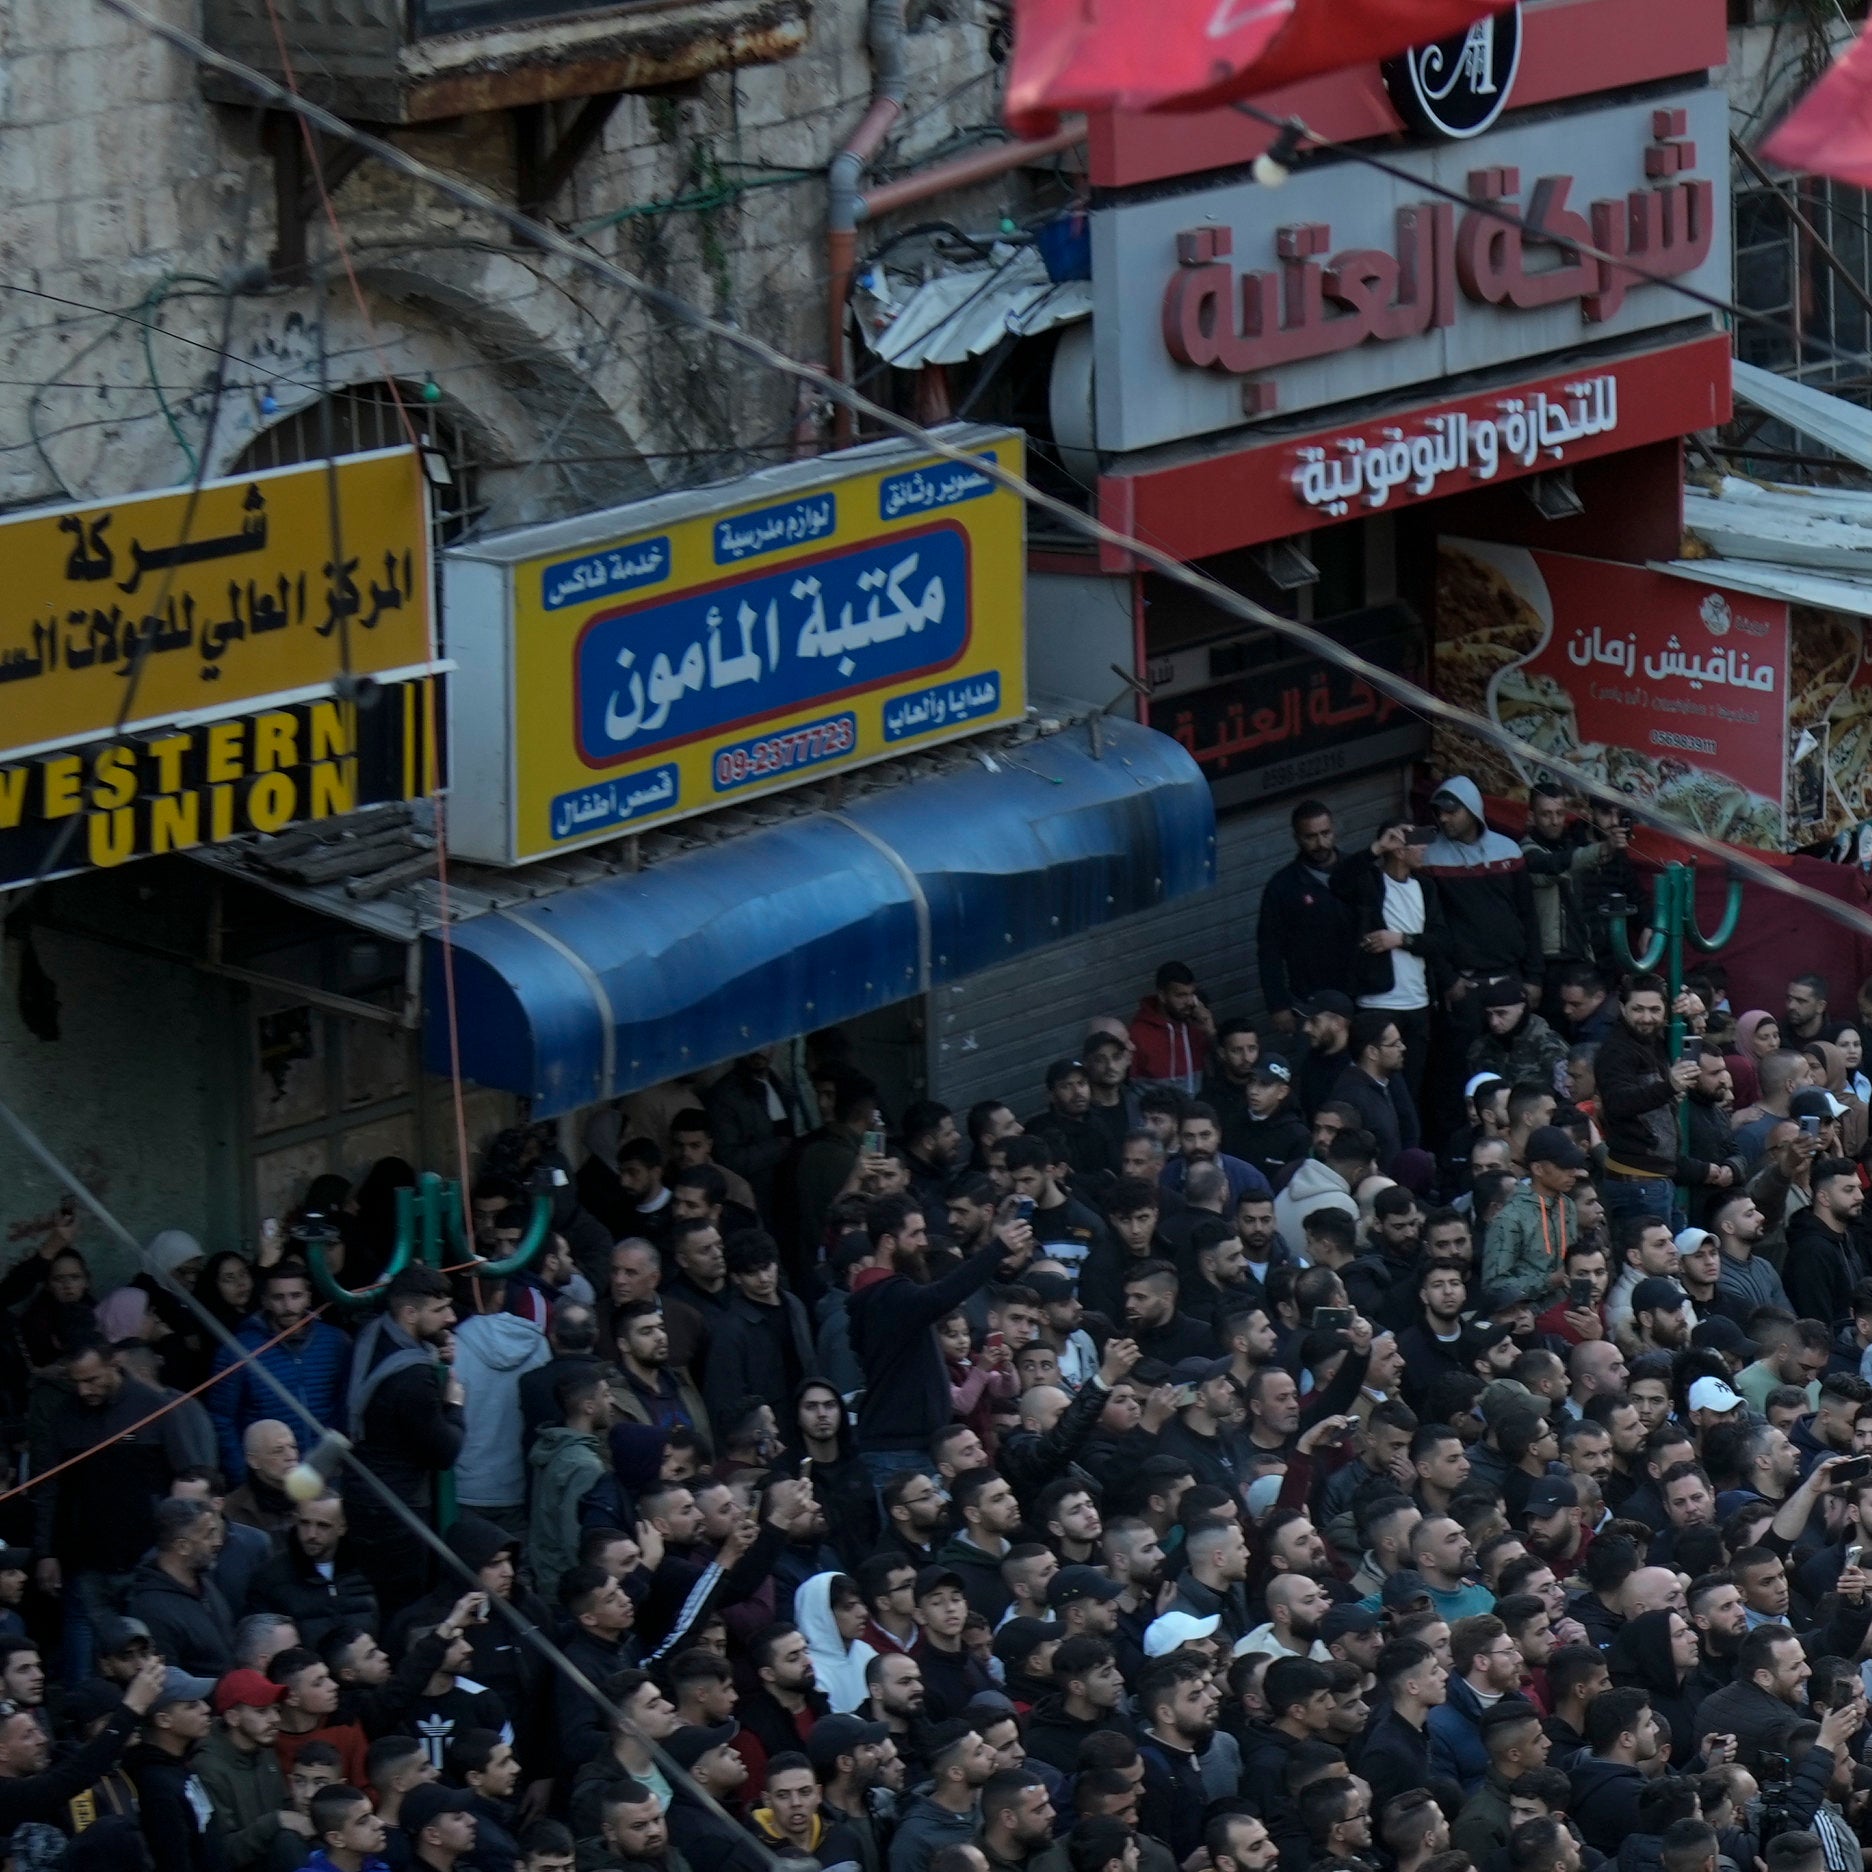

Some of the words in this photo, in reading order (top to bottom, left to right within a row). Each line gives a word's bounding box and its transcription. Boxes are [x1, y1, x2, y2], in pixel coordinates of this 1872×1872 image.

[1457, 108, 1713, 322] شركة
[1162, 201, 1454, 415] العتبة
[1469, 417, 1498, 479] و
[1500, 375, 1617, 464] للتجارة
[59, 482, 267, 594] شركة
[720, 519, 783, 554] مدرسية
[784, 500, 831, 541] لوازم
[314, 546, 413, 637] المركز
[549, 560, 606, 606] فاكس
[609, 546, 663, 582] خدمة
[201, 570, 306, 680] العالمي
[791, 552, 946, 677] مكتبة
[604, 598, 781, 741] المأمون
[1568, 626, 1637, 678] زمان
[1644, 634, 1775, 692] مناقيش
[886, 691, 946, 734] وألعاب
[948, 682, 997, 715] هدايا
[715, 717, 854, 784] 09-2377723
[88, 756, 358, 868] UNION
[557, 784, 617, 834] أطفال
[620, 770, 674, 808] قصص
